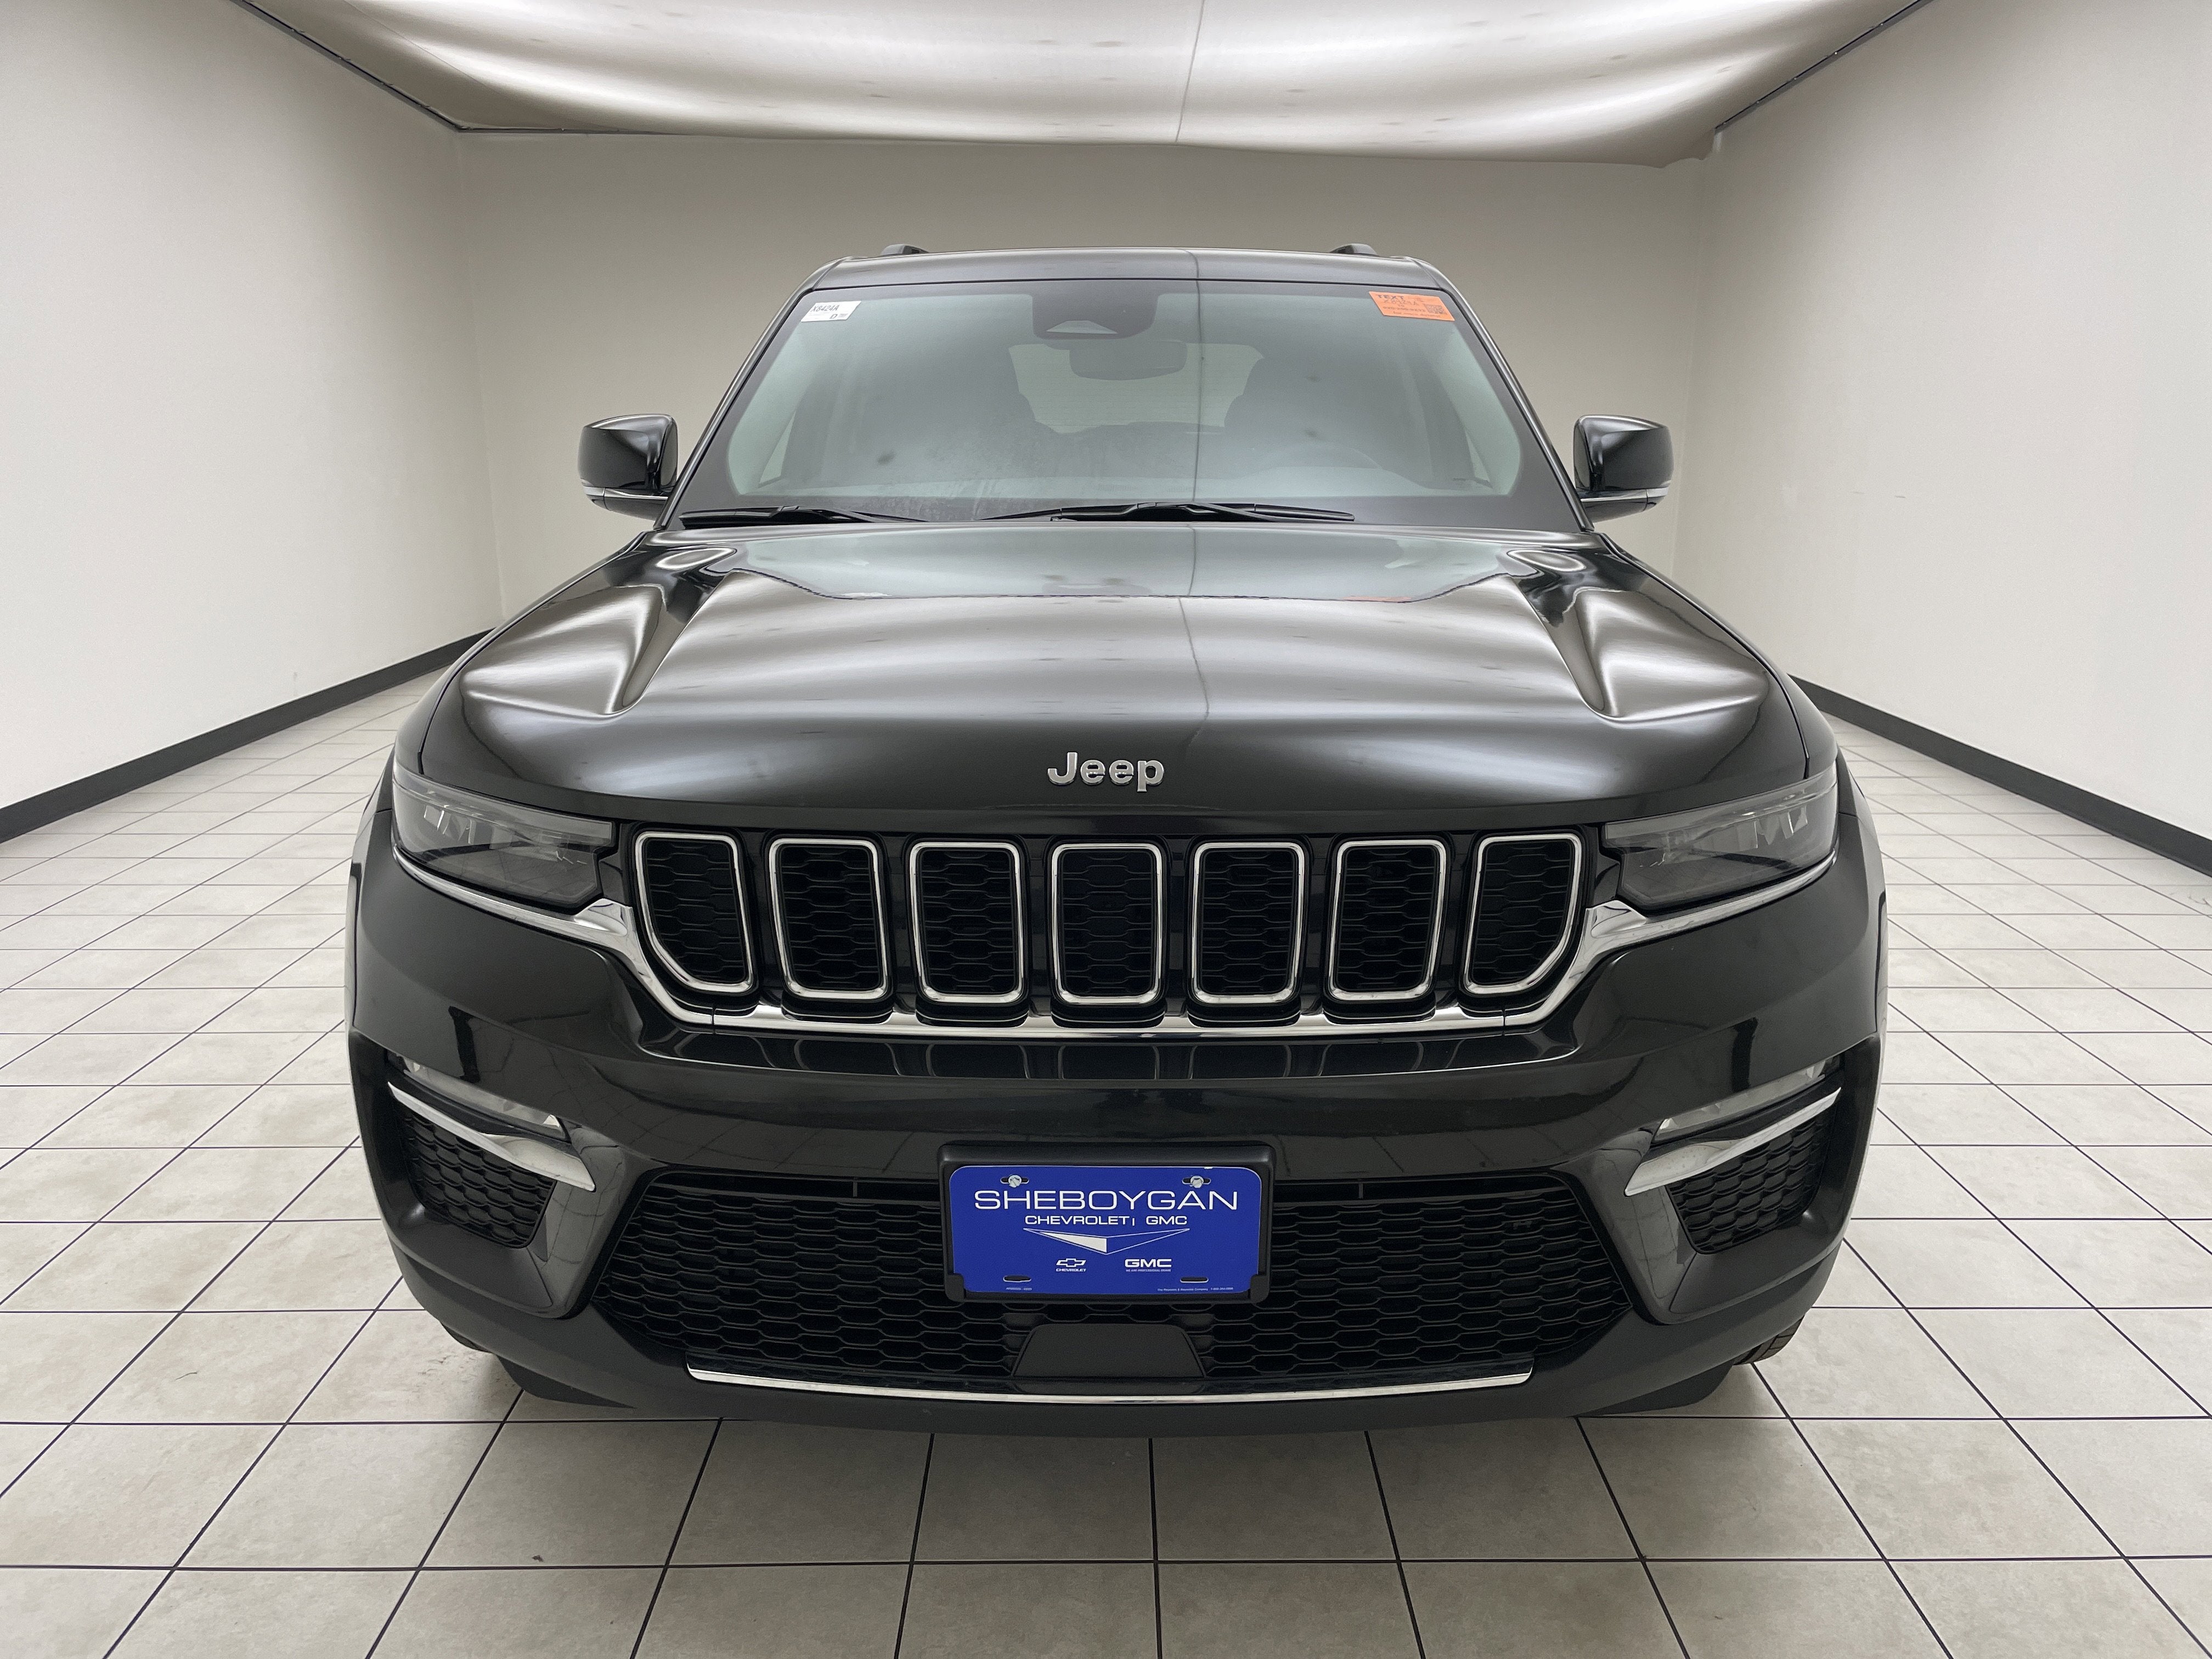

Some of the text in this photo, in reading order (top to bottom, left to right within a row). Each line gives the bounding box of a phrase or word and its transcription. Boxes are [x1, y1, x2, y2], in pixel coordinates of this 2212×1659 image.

[1047, 752, 1165, 793] Jeep
[974, 1190, 1238, 1210] SHEBOYGAN
[1025, 1215, 1188, 1225] CHEVROLET GMC
[1125, 1259, 1172, 1267] GMC
